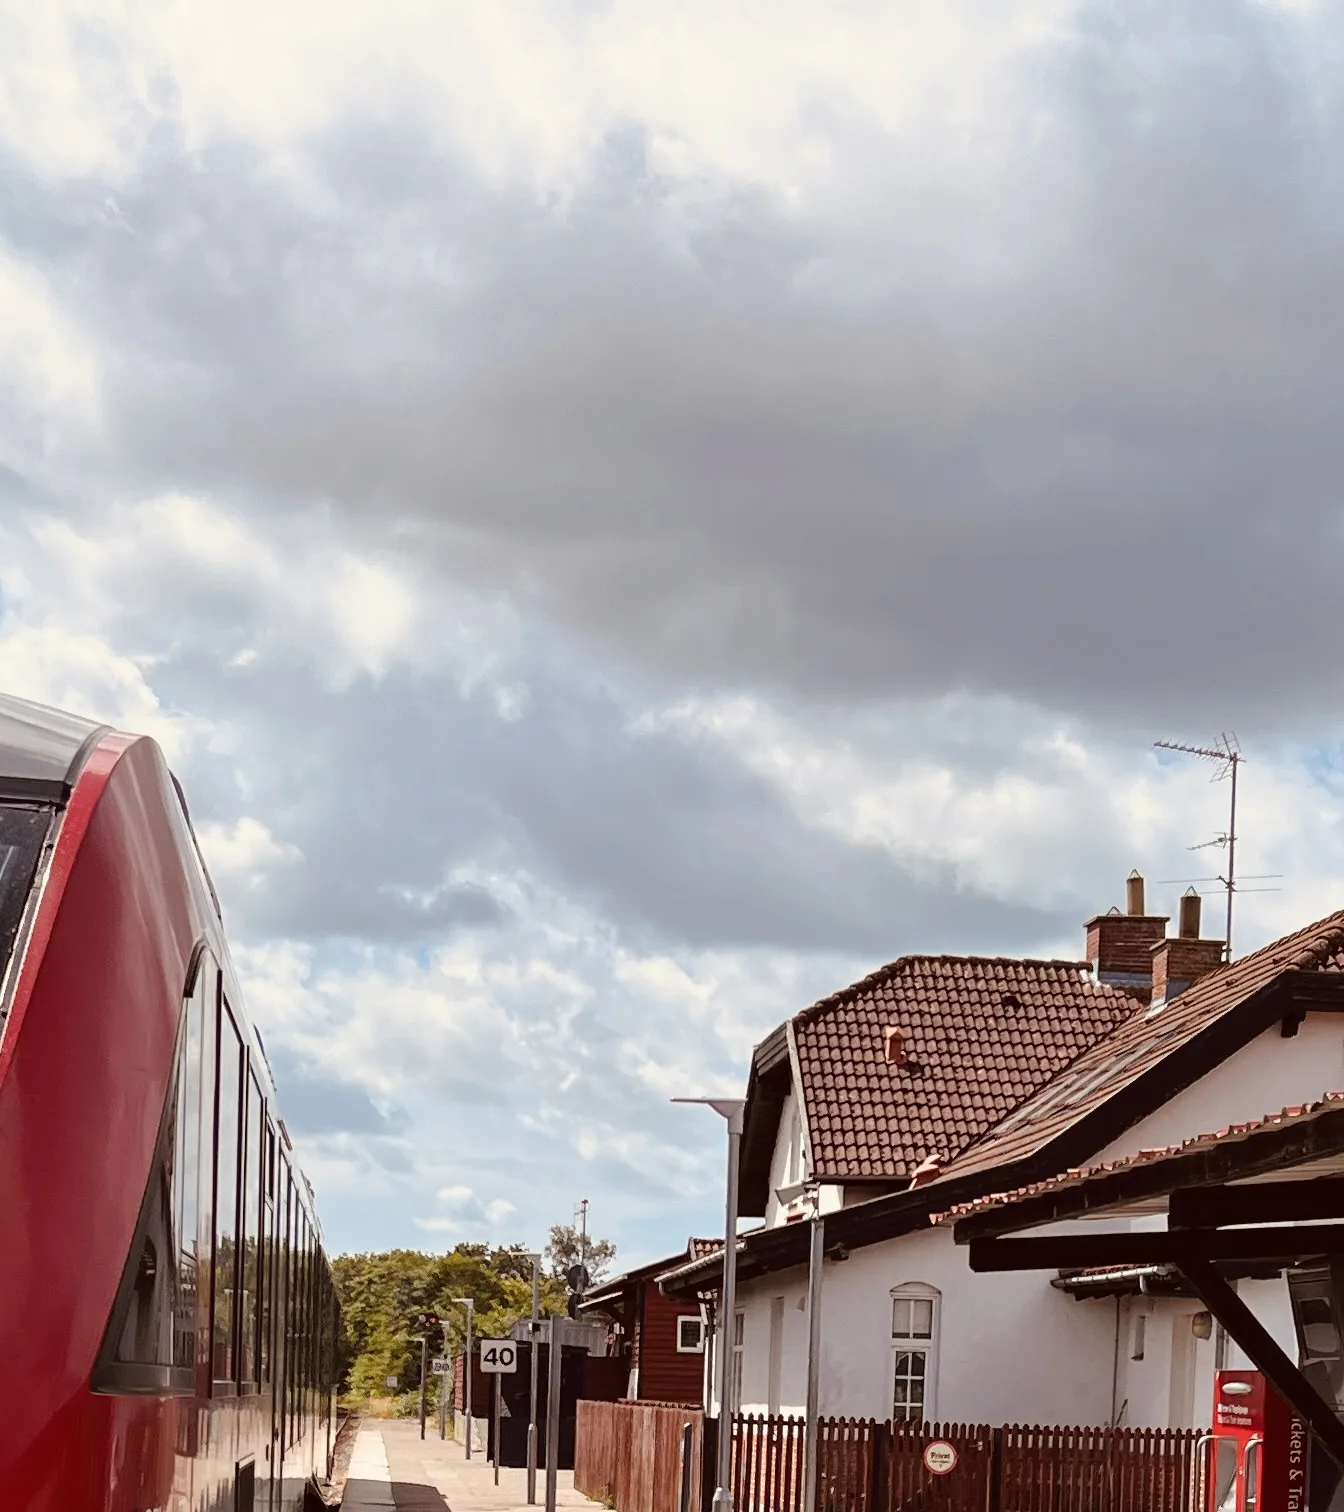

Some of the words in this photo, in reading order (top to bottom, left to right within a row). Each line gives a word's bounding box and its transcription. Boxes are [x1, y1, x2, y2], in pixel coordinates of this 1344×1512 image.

[483, 1347, 515, 1367] 40
[1290, 1417, 1306, 1463] ickets
[1288, 1468, 1304, 1481] &
